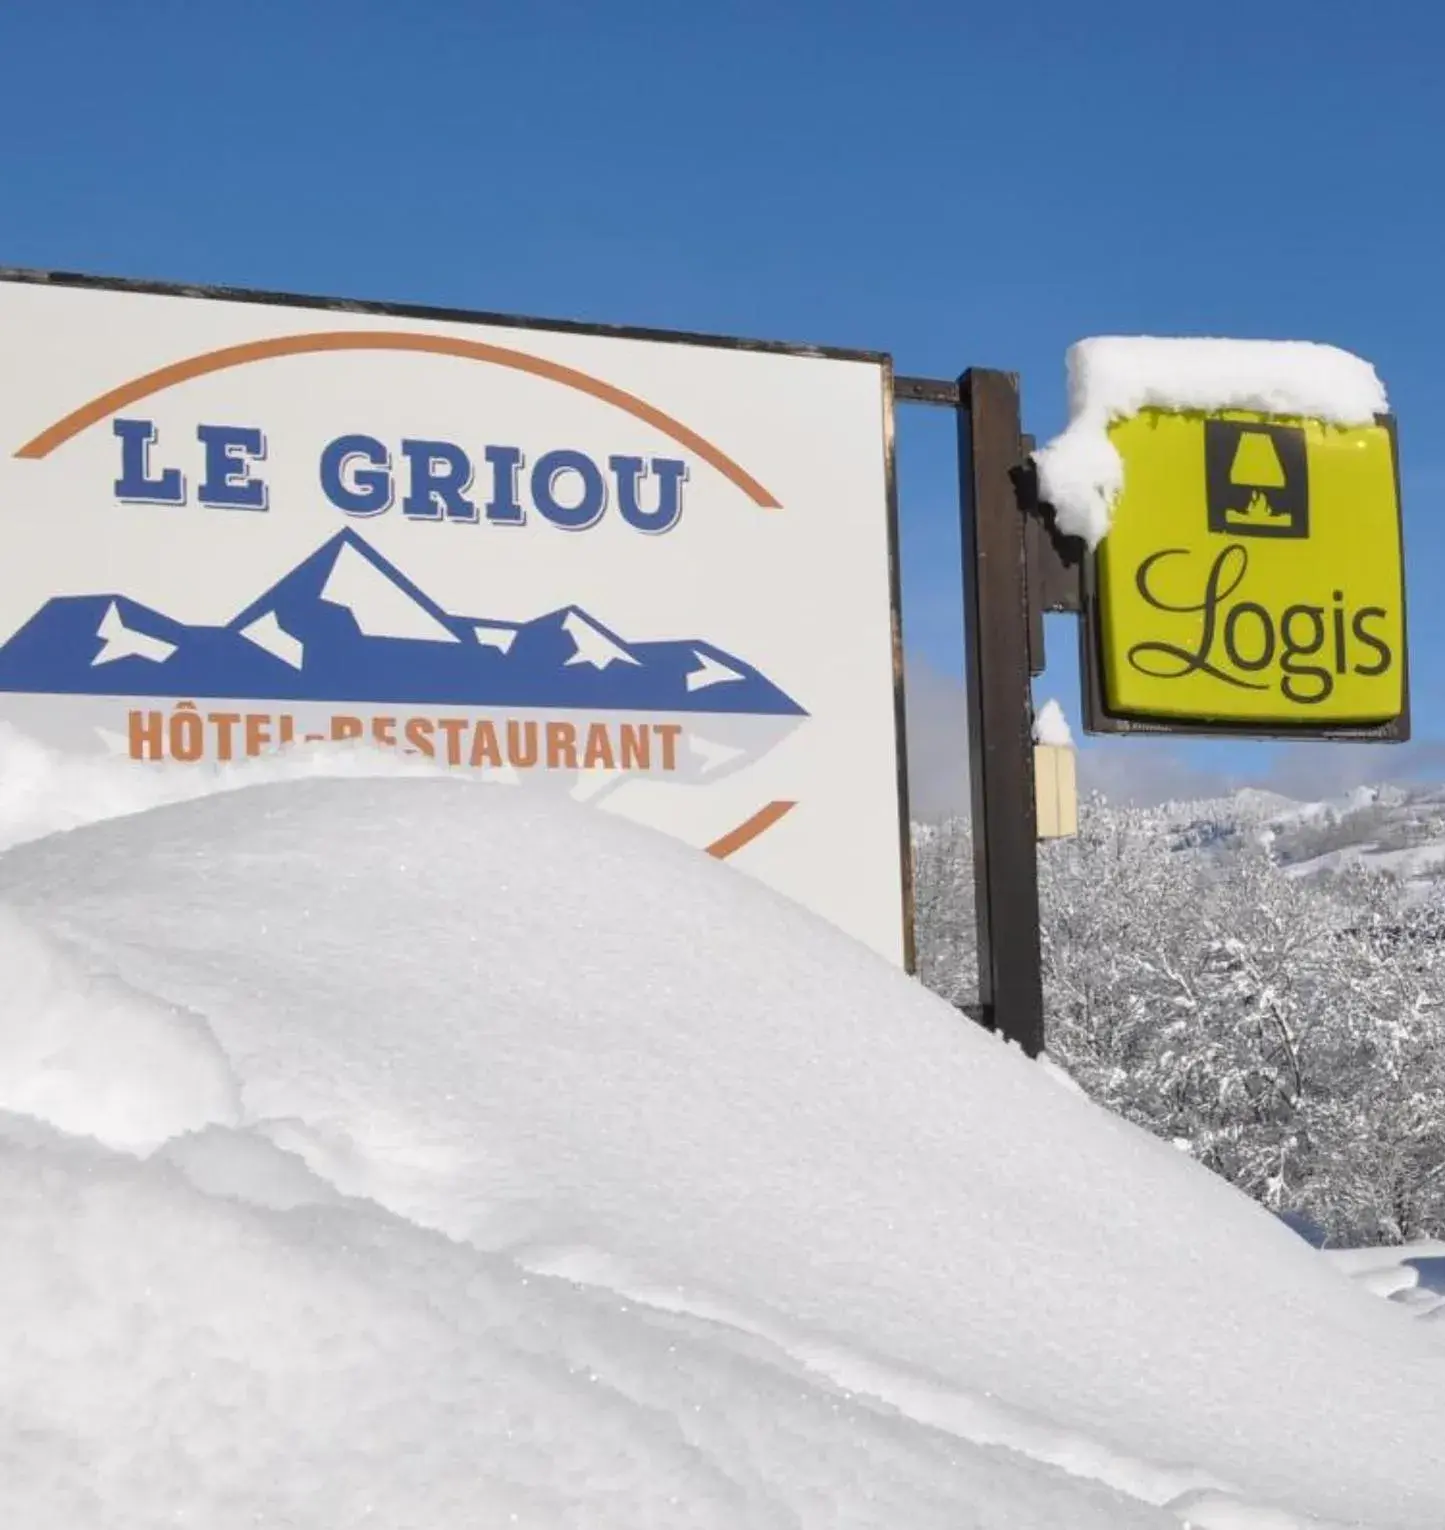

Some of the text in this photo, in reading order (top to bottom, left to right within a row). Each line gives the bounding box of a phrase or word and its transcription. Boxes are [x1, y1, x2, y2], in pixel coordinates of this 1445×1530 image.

[113, 418, 689, 534] LE GRIOU
[1128, 544, 1391, 704] Logis
